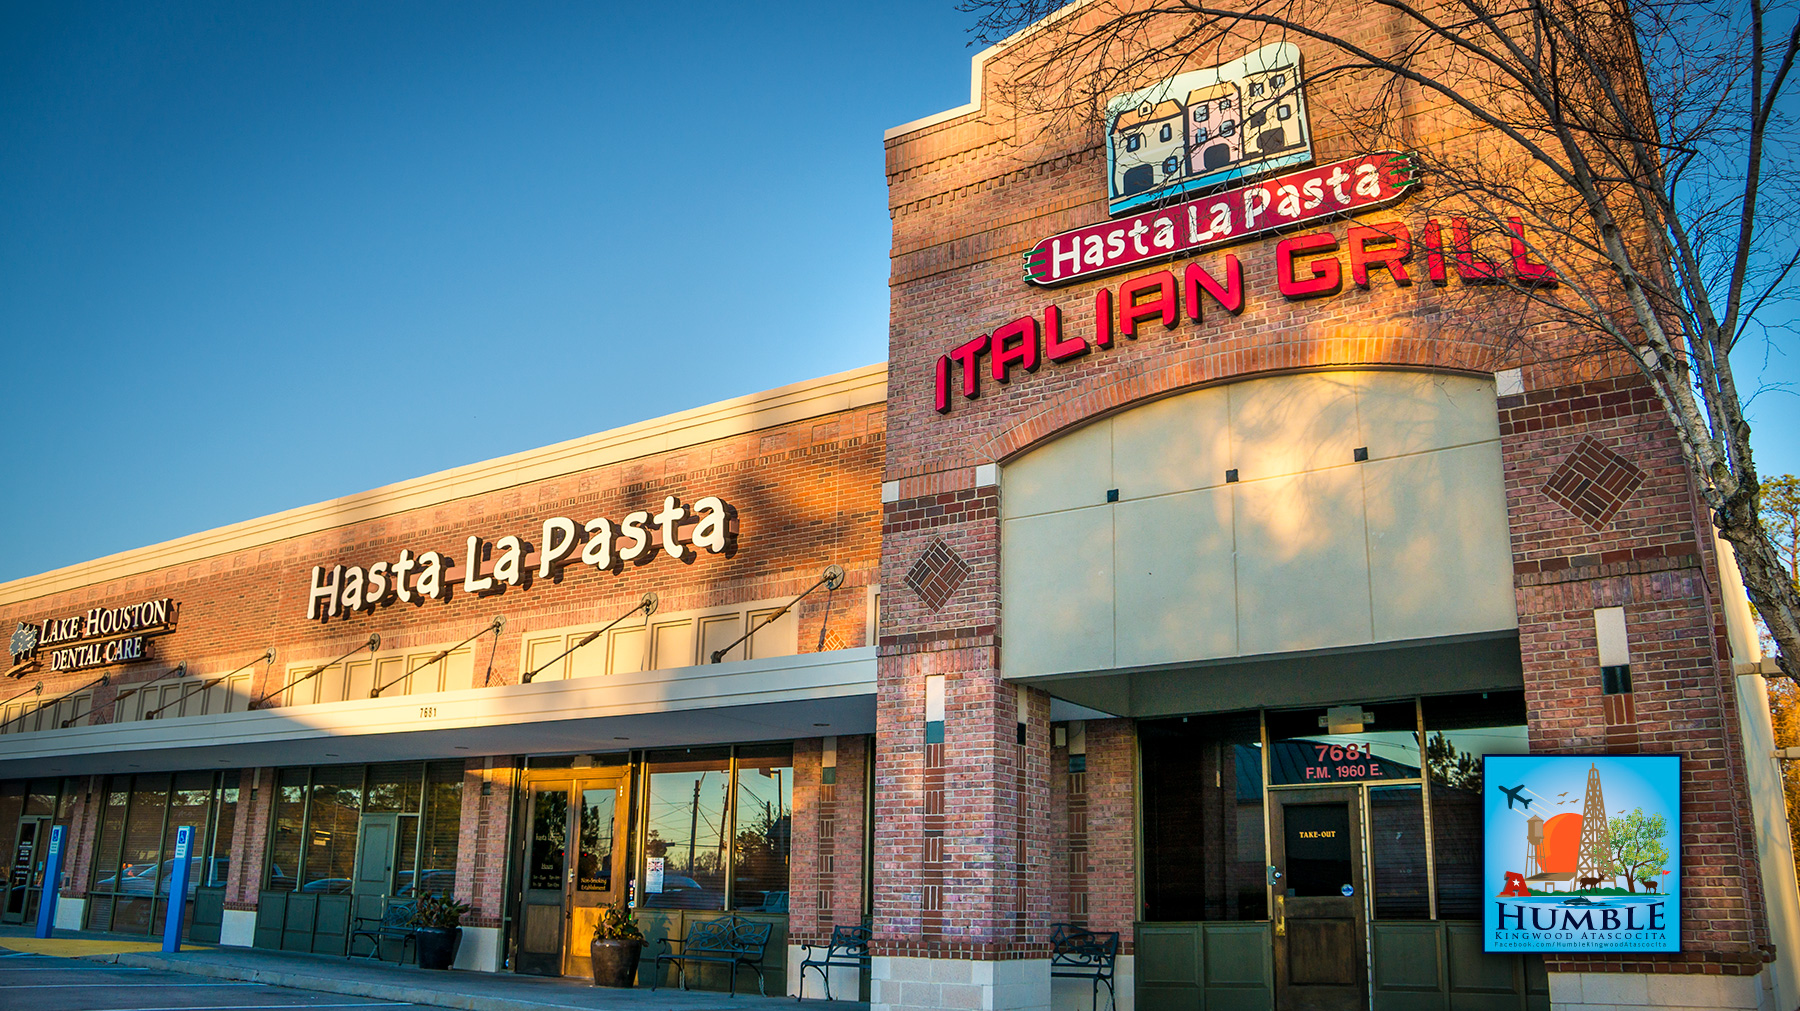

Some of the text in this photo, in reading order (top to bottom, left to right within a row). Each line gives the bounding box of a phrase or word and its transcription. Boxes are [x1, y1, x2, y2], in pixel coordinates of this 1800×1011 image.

[1052, 163, 1381, 278] Hasta La Pasta
[935, 216, 1559, 414] ITALIAN GRILL
[307, 495, 727, 620] Hasta La Pasta
[38, 598, 169, 645] LAKE HOUSTON
[51, 636, 143, 671] DENTAL CARE
[419, 707, 437, 718] 7681
[1315, 742, 1371, 762] 7681
[1305, 763, 1383, 779] F.M. 1960 E.
[1299, 830, 1336, 838] TAKE-OUT
